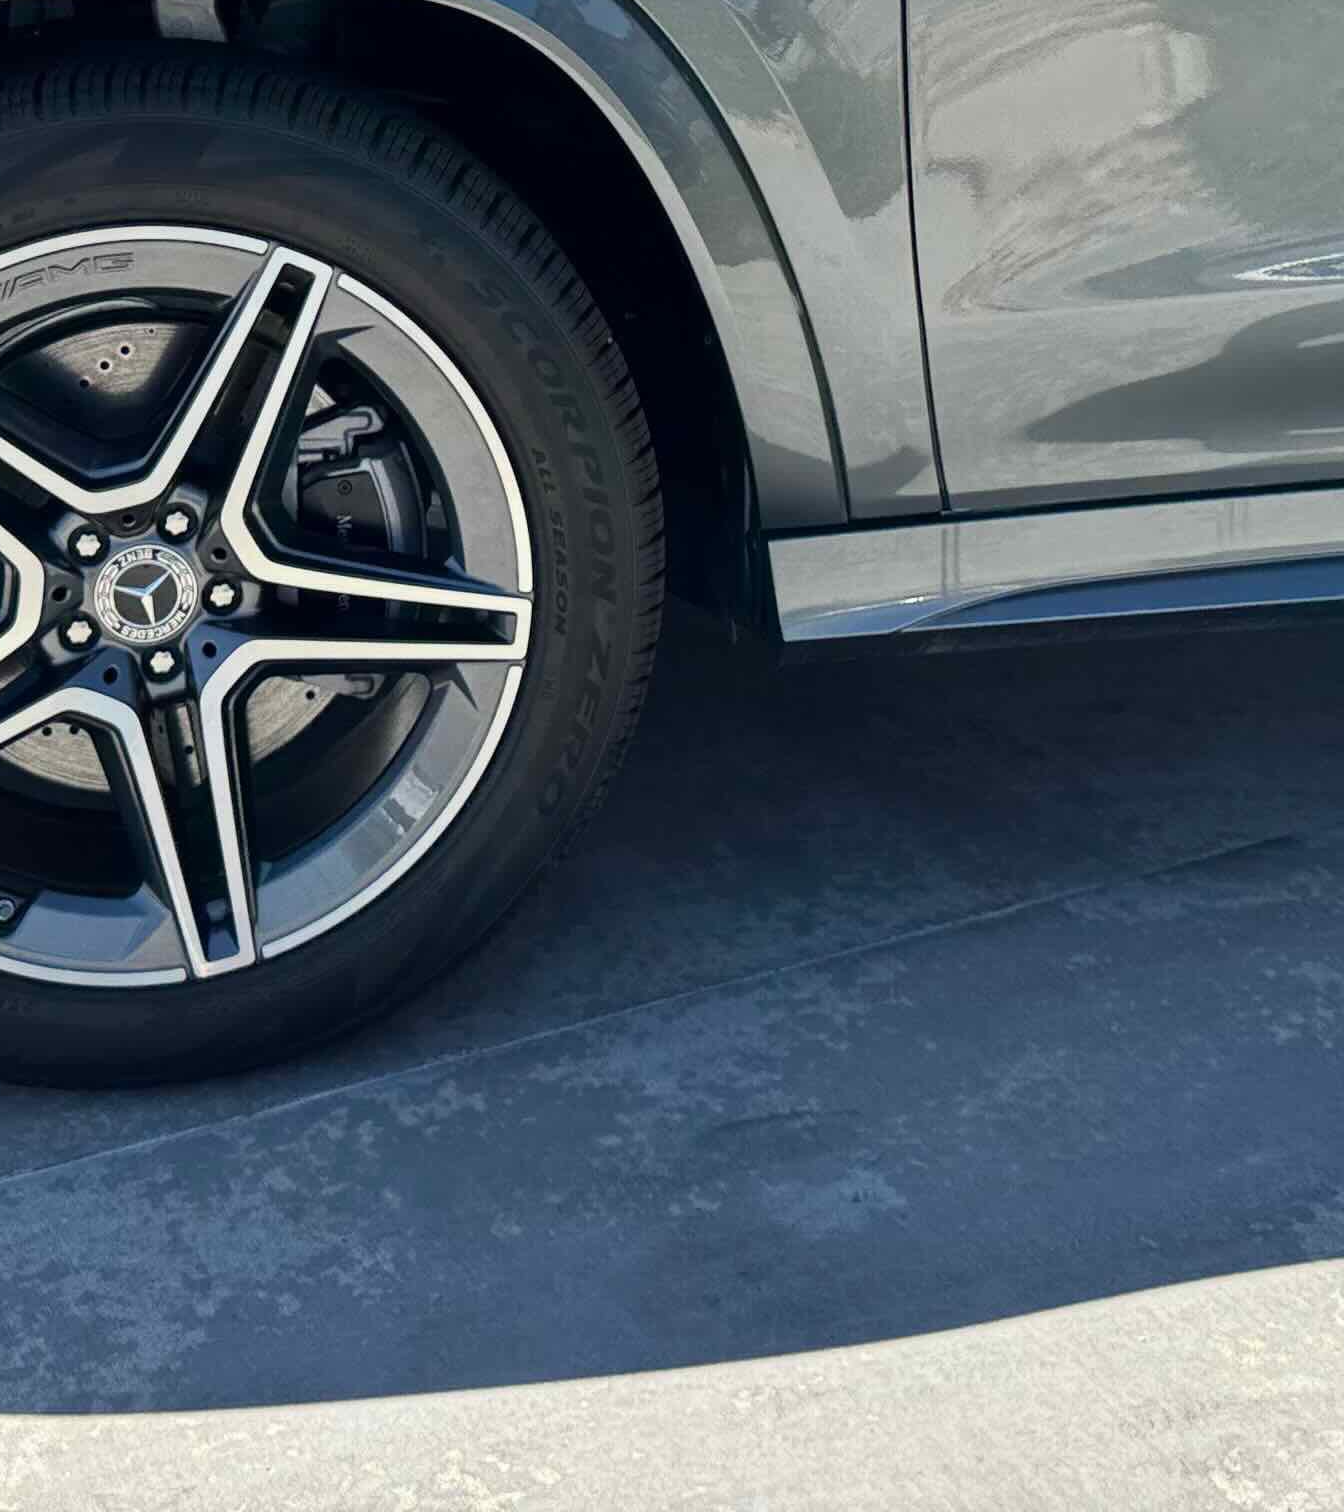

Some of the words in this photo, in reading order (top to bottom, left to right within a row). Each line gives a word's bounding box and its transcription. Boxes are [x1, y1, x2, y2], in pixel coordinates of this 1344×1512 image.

[463, 278, 617, 606] SCORPION
[531, 446, 559, 496] ALL
[549, 506, 570, 637] SEASON
